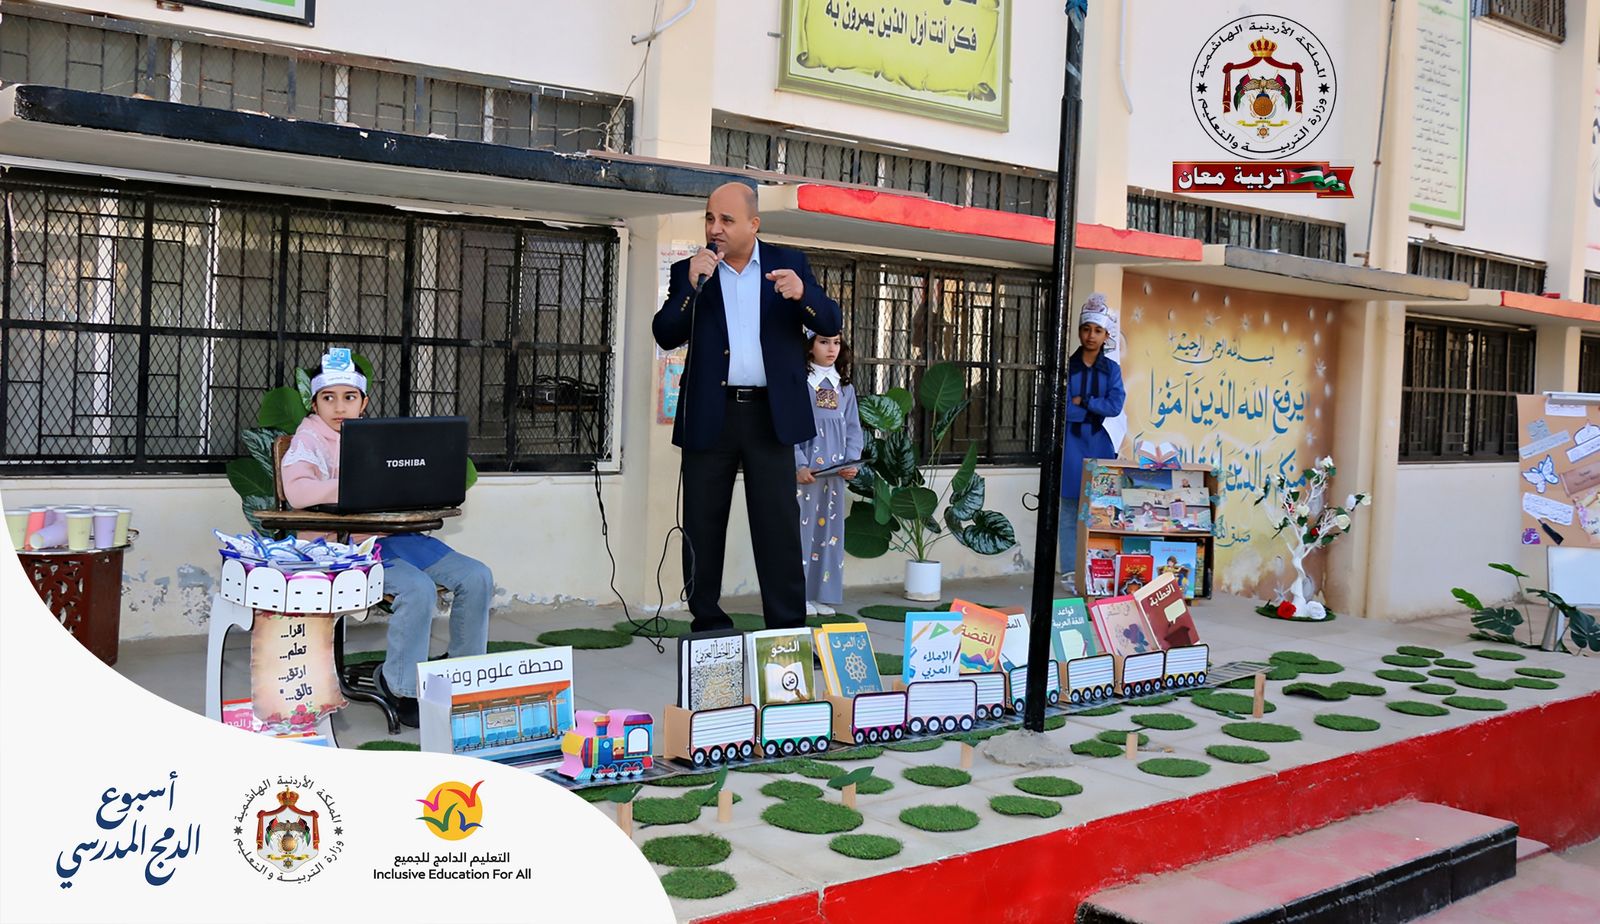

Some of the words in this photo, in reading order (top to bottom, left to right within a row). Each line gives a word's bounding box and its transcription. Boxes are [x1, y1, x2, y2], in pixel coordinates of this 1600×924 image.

[825, 1, 840, 27] به
[842, 1, 875, 34] يمرون
[877, 8, 907, 38] الذين
[910, 11, 927, 46] أول
[929, 16, 947, 43] أنت
[948, 27, 977, 54] فكن
[386, 458, 426, 468] TOSHIBA
[1149, 583, 1176, 606] الخطابة
[770, 640, 800, 658] النحو
[477, 662, 513, 688] علوم
[518, 657, 563, 676] محطة
[922, 665, 951, 680] العربي
